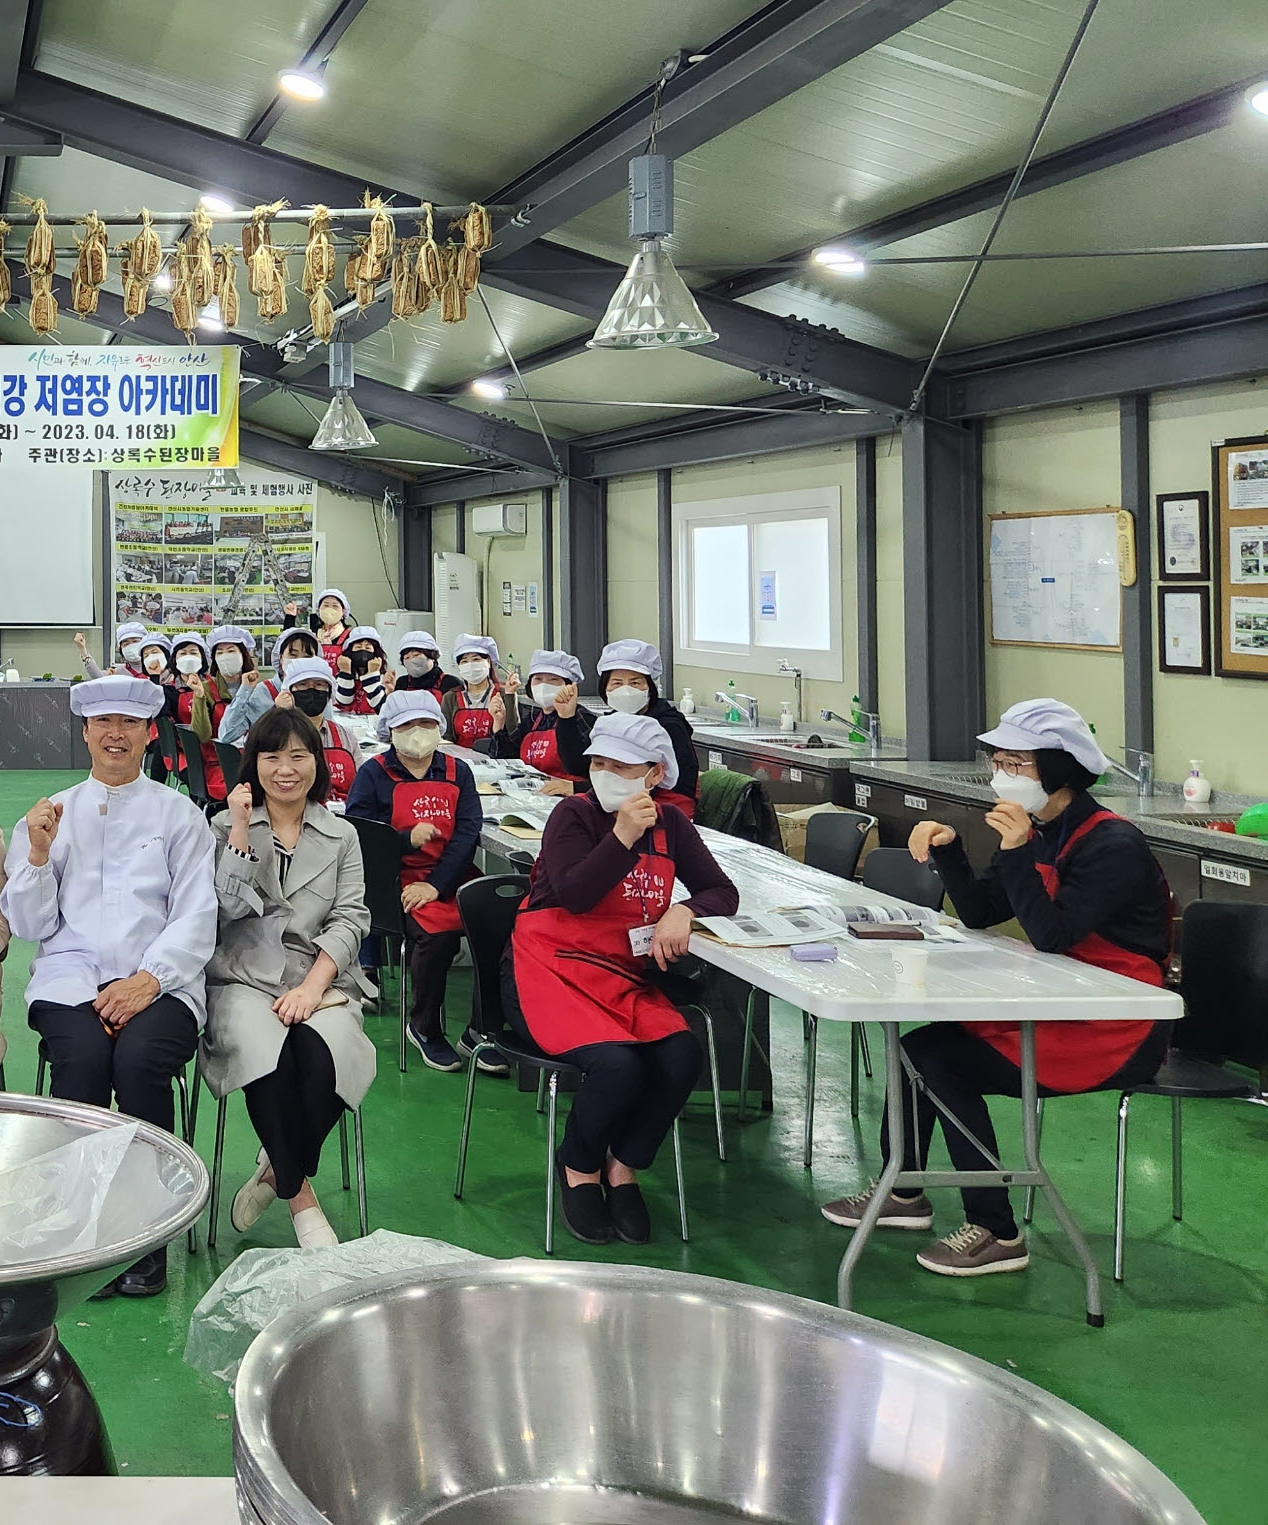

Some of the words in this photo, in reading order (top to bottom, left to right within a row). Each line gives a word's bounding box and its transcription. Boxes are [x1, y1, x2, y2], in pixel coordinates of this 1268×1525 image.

[179, 353, 211, 367] 안산
[34, 373, 111, 417] 저염장
[118, 373, 218, 416] 아카데미
[42, 424, 89, 440] 2023.
[94, 424, 120, 440] 04.
[126, 423, 176, 440] 18(화)
[28, 447, 108, 463] 주관(장소):
[111, 446, 220, 463] 상록수된장마을
[262, 483, 294, 496] 체험행사
[297, 482, 313, 495] 사진
